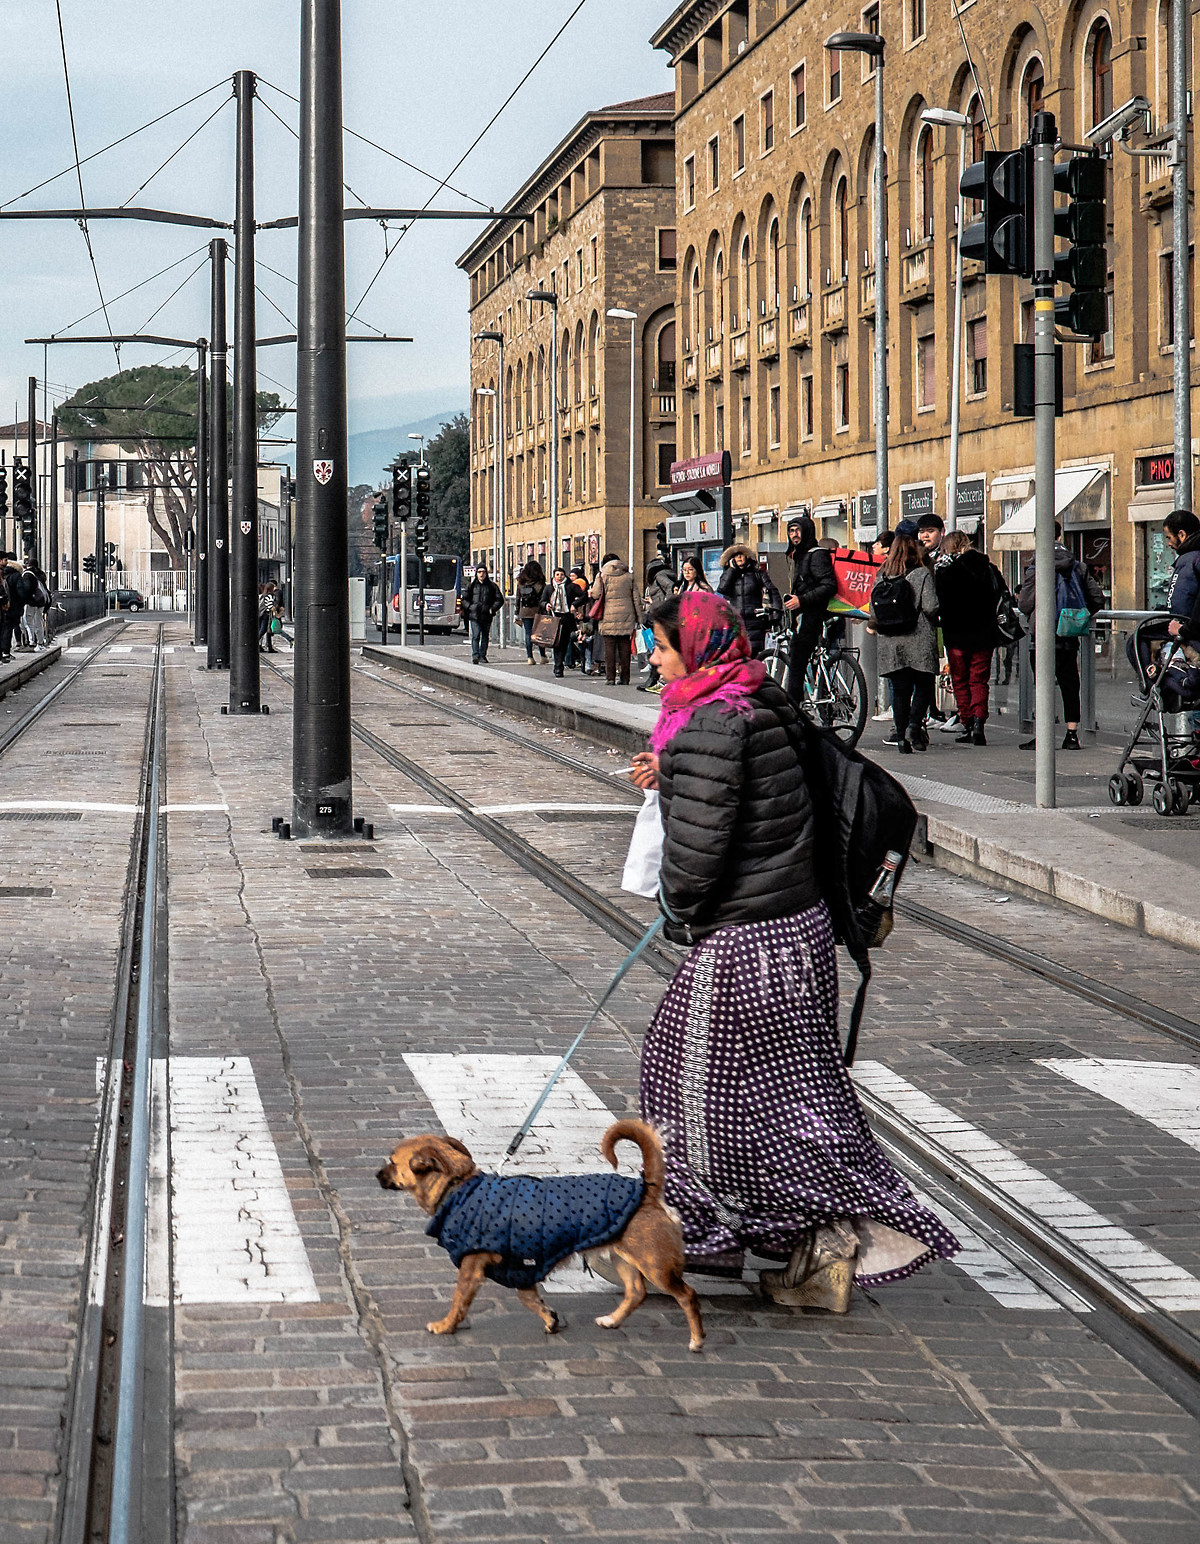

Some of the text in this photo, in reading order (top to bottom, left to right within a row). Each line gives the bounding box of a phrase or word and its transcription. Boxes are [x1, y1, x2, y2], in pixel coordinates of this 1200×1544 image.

[907, 491, 930, 510] Tabacchi
[956, 486, 983, 504] asticceria
[862, 499, 872, 515] Bar
[843, 570, 872, 583] JUST
[848, 581, 871, 593] EAT
[319, 806, 332, 814] 275
